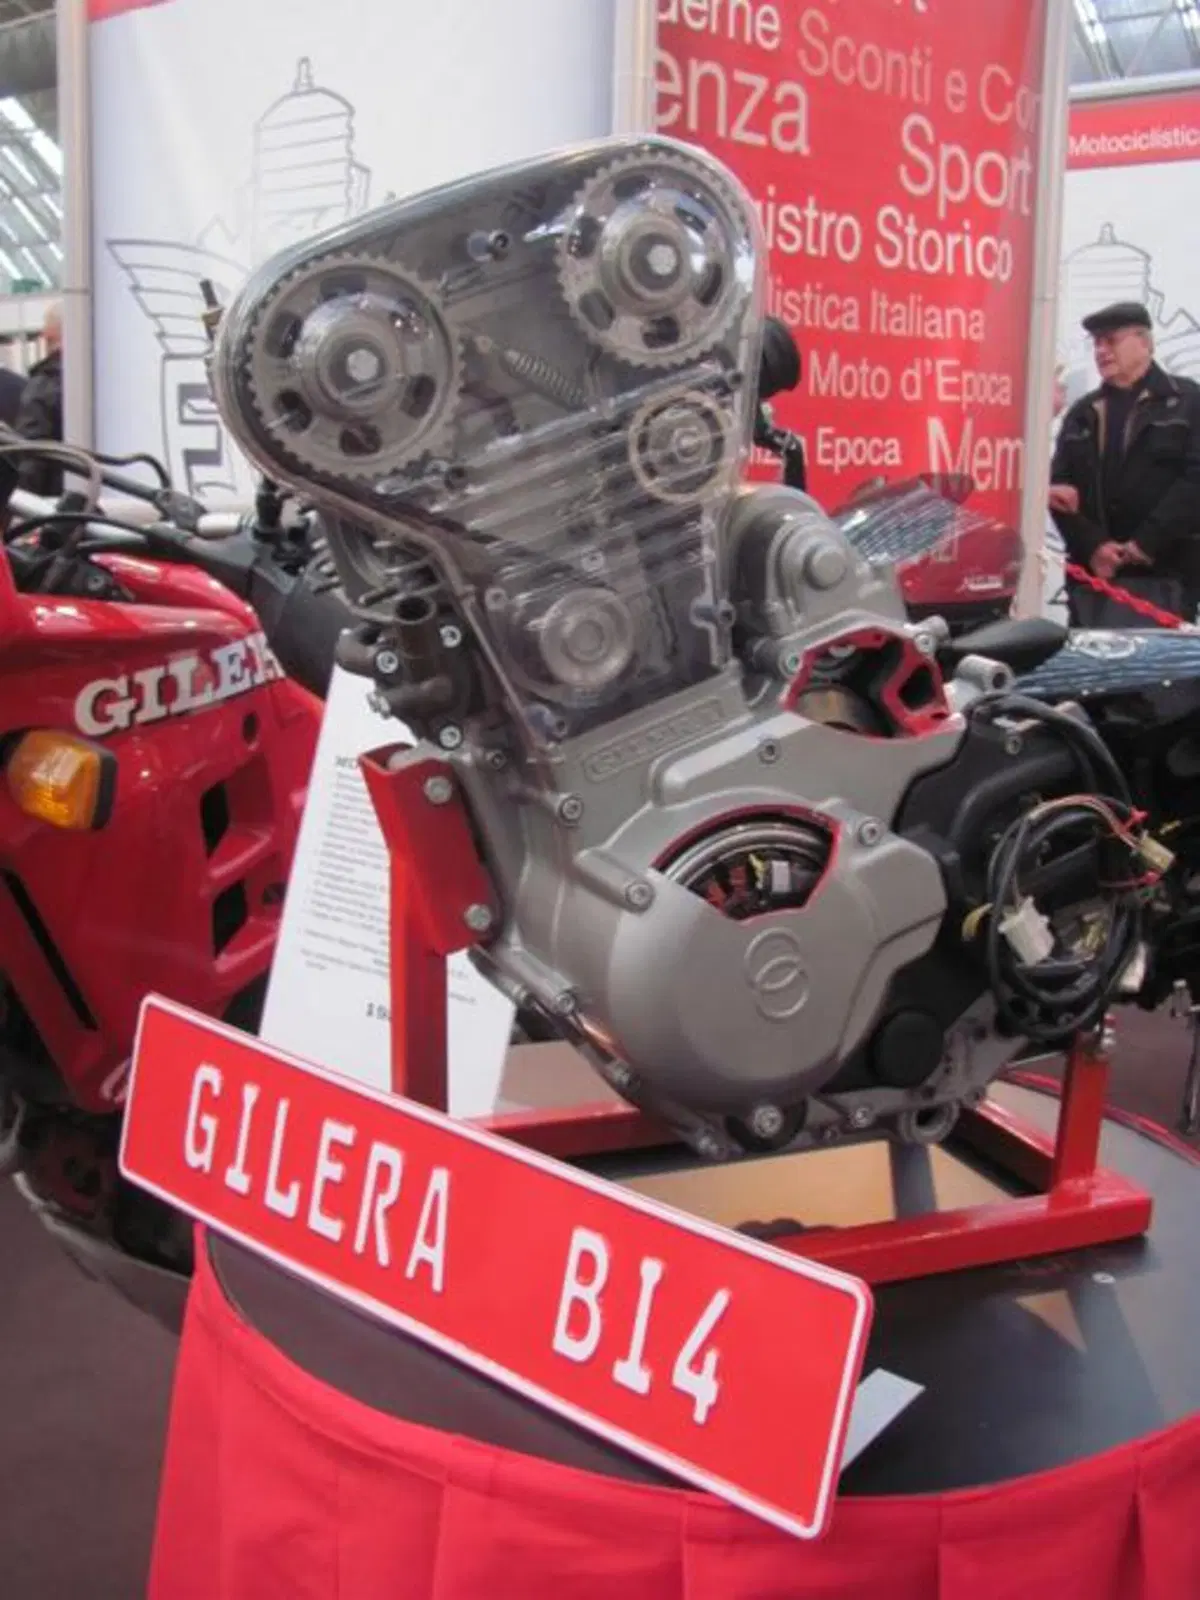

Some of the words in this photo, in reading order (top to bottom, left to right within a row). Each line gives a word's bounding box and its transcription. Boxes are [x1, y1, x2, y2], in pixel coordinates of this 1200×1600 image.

[799, 8, 933, 104] Sconti
[944, 68, 967, 113] e
[897, 112, 1031, 221] Sport
[754, 184, 861, 263] istro
[874, 204, 1012, 281] Storico
[869, 288, 985, 342] Italiana
[808, 350, 890, 401] Moto
[815, 426, 902, 474] Epoca
[183, 1063, 450, 1293] GILERA
[552, 1223, 731, 1424] BI4
